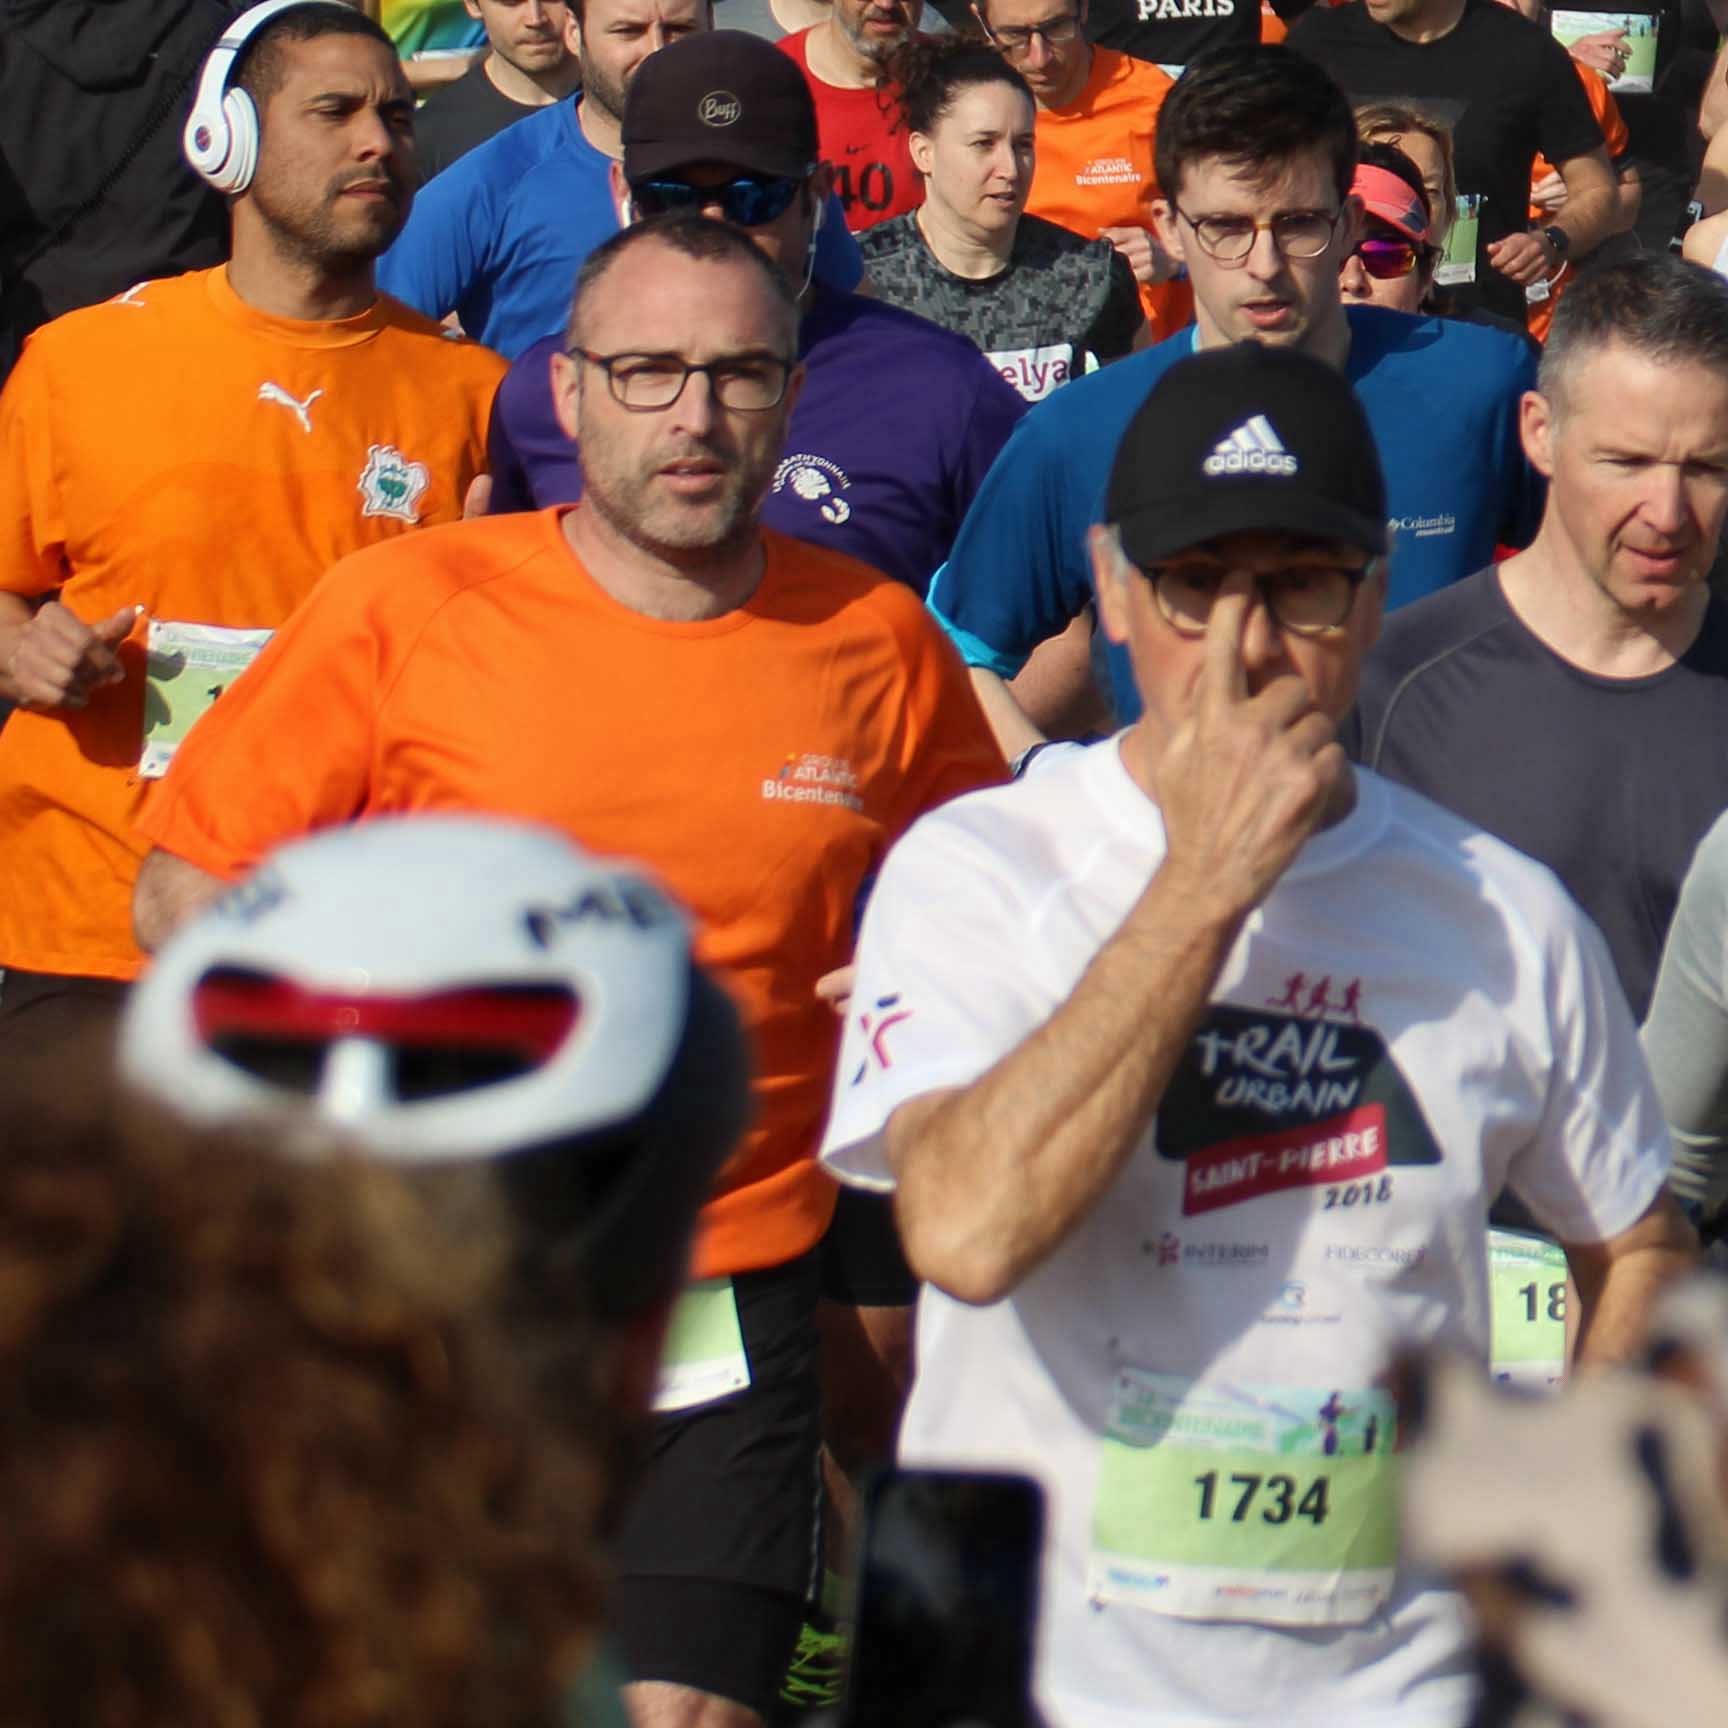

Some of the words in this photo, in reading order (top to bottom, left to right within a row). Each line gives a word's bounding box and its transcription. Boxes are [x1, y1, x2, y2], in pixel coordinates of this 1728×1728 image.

[1204, 453, 1298, 476] adidas
[1217, 1075, 1360, 1110] URBAIN
[1189, 1124, 1380, 1196] SAINT-PIERRE
[1324, 1180, 1396, 1212] 2018
[1193, 1469, 1332, 1526] 1734
